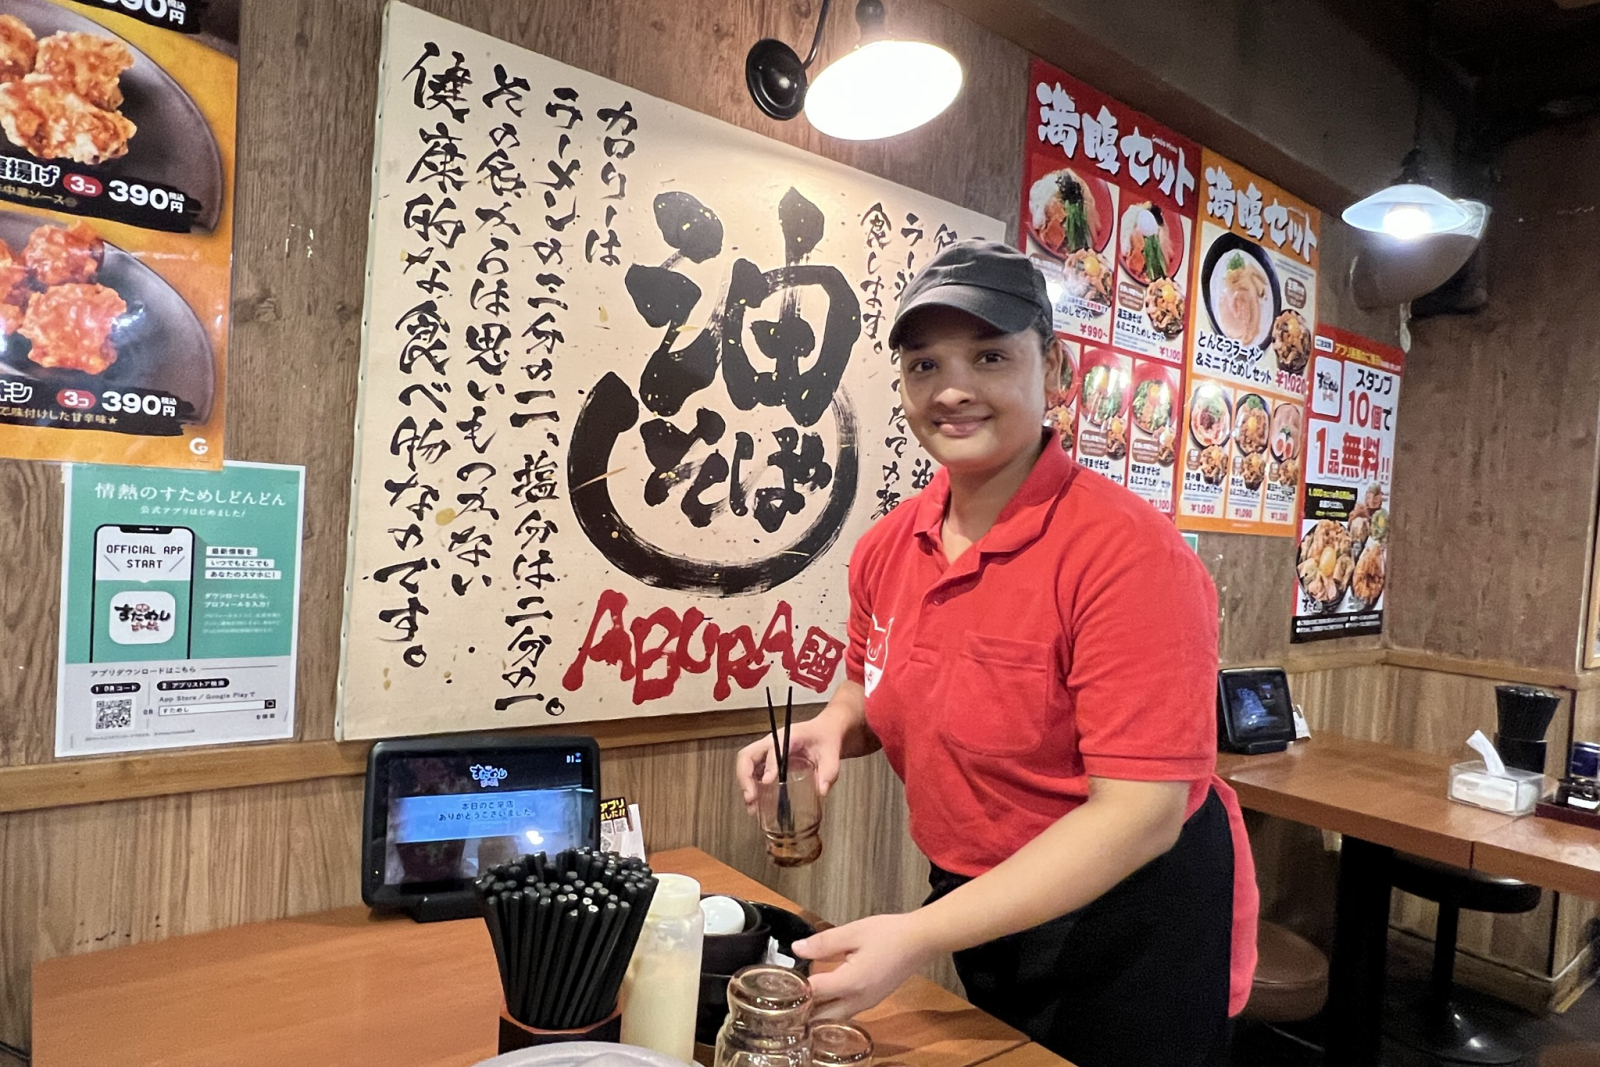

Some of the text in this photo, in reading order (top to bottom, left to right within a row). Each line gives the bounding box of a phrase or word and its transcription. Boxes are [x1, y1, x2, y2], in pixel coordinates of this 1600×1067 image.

[1036, 82, 1195, 206] 満腹セット
[108, 180, 168, 210] 390
[170, 201, 184, 213] 円
[585, 101, 638, 266] カロリーは
[1205, 166, 1318, 264] 満腹セット
[625, 186, 861, 427] 油
[1355, 368, 1393, 396] スタンプ
[101, 391, 161, 416] 390
[162, 405, 176, 417] 円
[1348, 389, 1393, 431] 10個で
[189, 438, 209, 455] G
[639, 407, 833, 534] そば
[95, 482, 286, 507] 情熱のすためしどんどん
[106, 544, 184, 555] OFFICIAL APP
[126, 559, 163, 569] START
[562, 589, 795, 705] ABURA
[90, 665, 196, 677] アプリダウンロードはこちら
[206, 692, 231, 701] Google
[600, 798, 625, 813] アプリ
